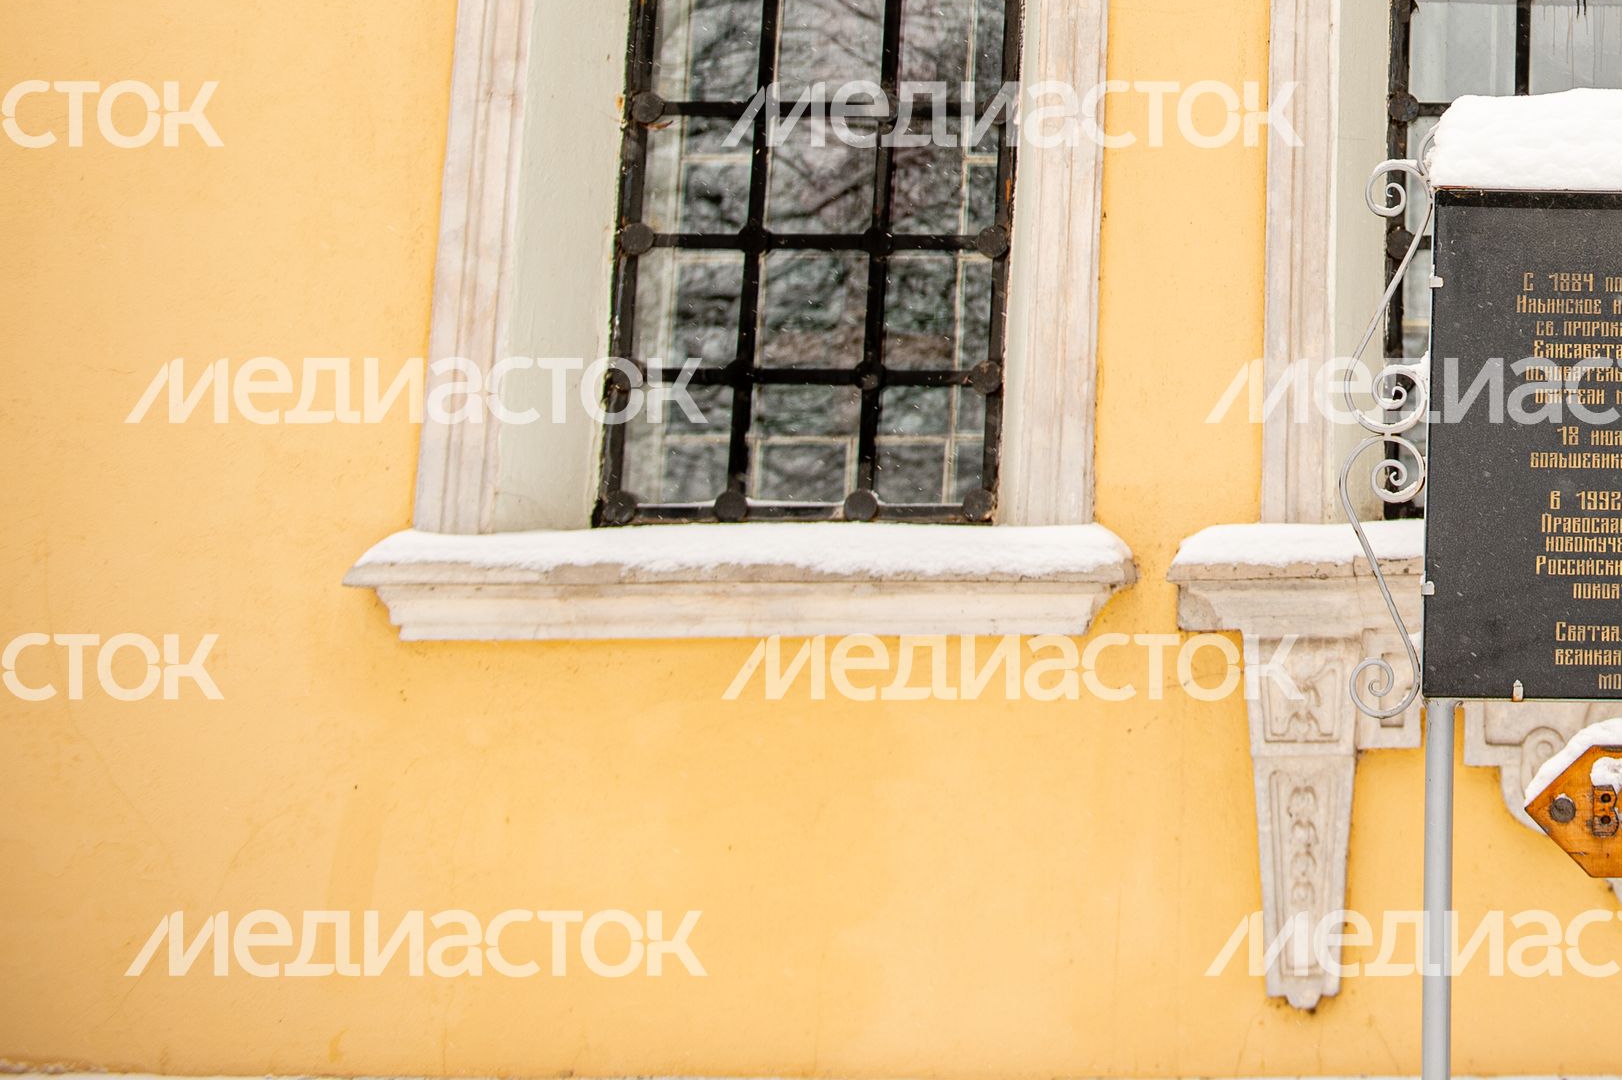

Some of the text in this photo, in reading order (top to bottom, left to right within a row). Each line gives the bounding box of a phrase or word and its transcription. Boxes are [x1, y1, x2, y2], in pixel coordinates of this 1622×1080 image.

[1523, 272, 1534, 292] С
[1549, 273, 1594, 293] 1884
[1605, 276, 1622, 293] по
[1516, 294, 1602, 315] Ильинское
[1613, 298, 1622, 315] и
[1556, 426, 1579, 447] 18
[1550, 490, 1561, 510] В
[1555, 621, 1620, 642] Святая
[1555, 648, 1622, 665] великая
